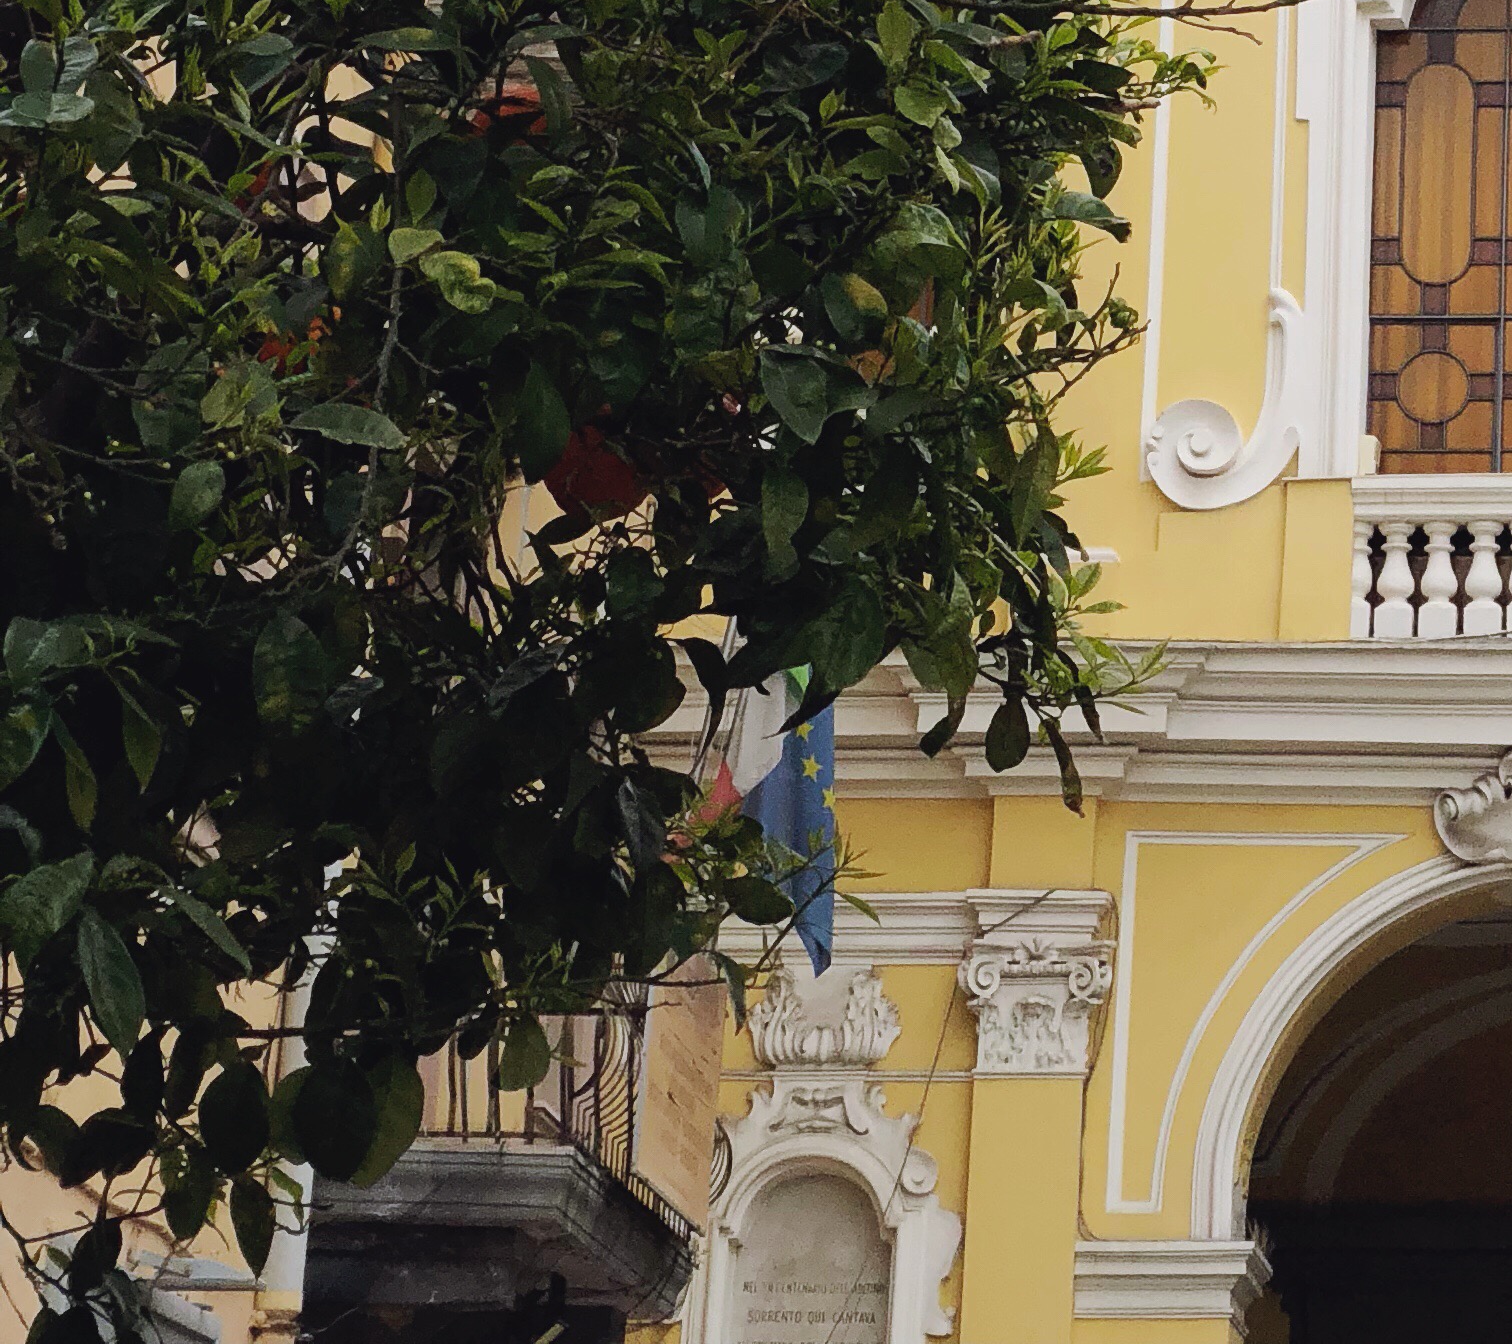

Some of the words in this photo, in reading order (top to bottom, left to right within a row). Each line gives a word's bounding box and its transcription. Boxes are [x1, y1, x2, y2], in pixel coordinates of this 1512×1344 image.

[747, 1310, 802, 1323] SORRENTO
[807, 1310, 826, 1325] QUI
[832, 1310, 876, 1324] CANTAVA
